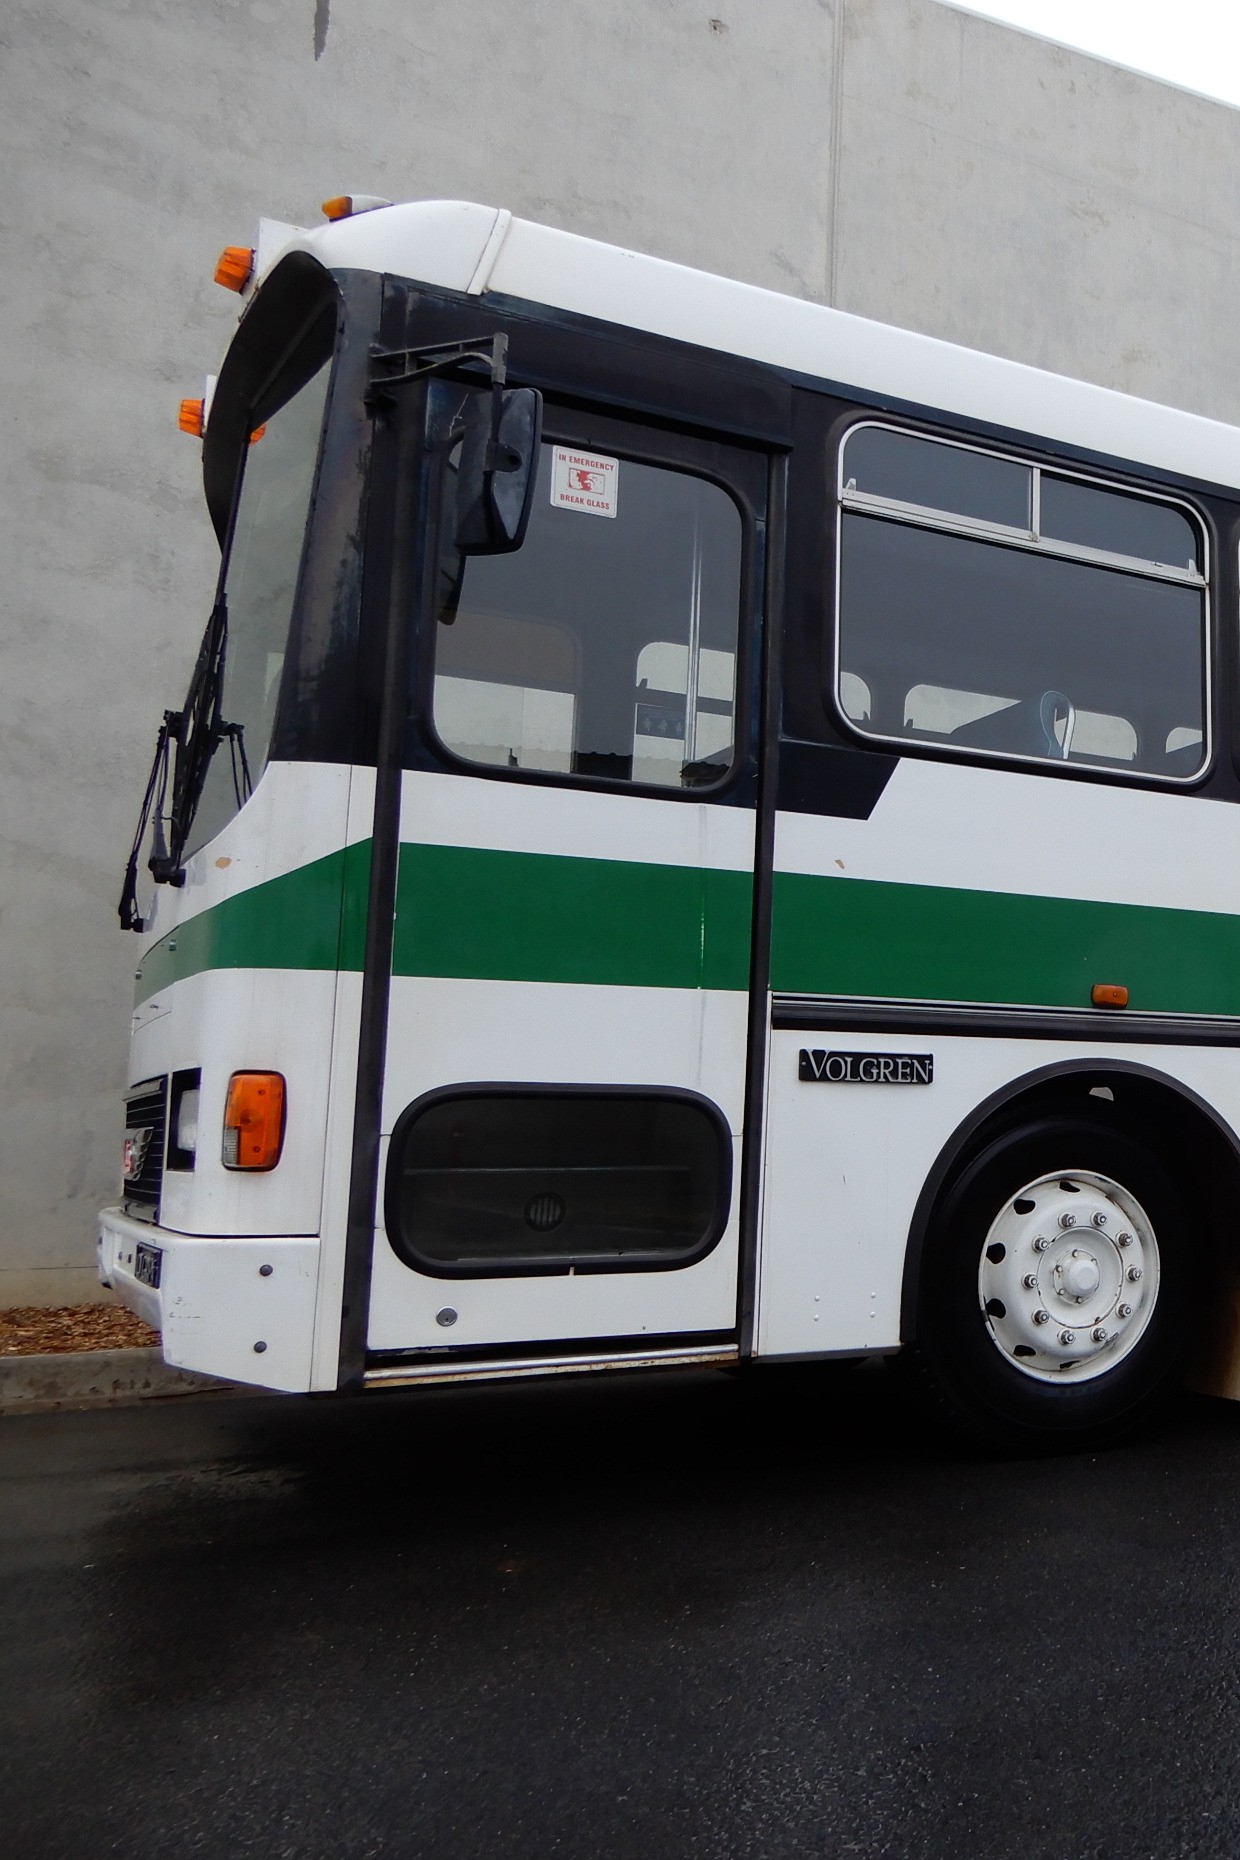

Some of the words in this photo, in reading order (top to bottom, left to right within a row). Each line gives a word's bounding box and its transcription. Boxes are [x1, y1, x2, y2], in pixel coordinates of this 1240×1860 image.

[558, 453, 567, 462] IN
[569, 456, 614, 471] EMERGENCY
[560, 493, 585, 505] BREAK
[586, 499, 609, 510] GLASS
[806, 1049, 930, 1083] VOLGREN
